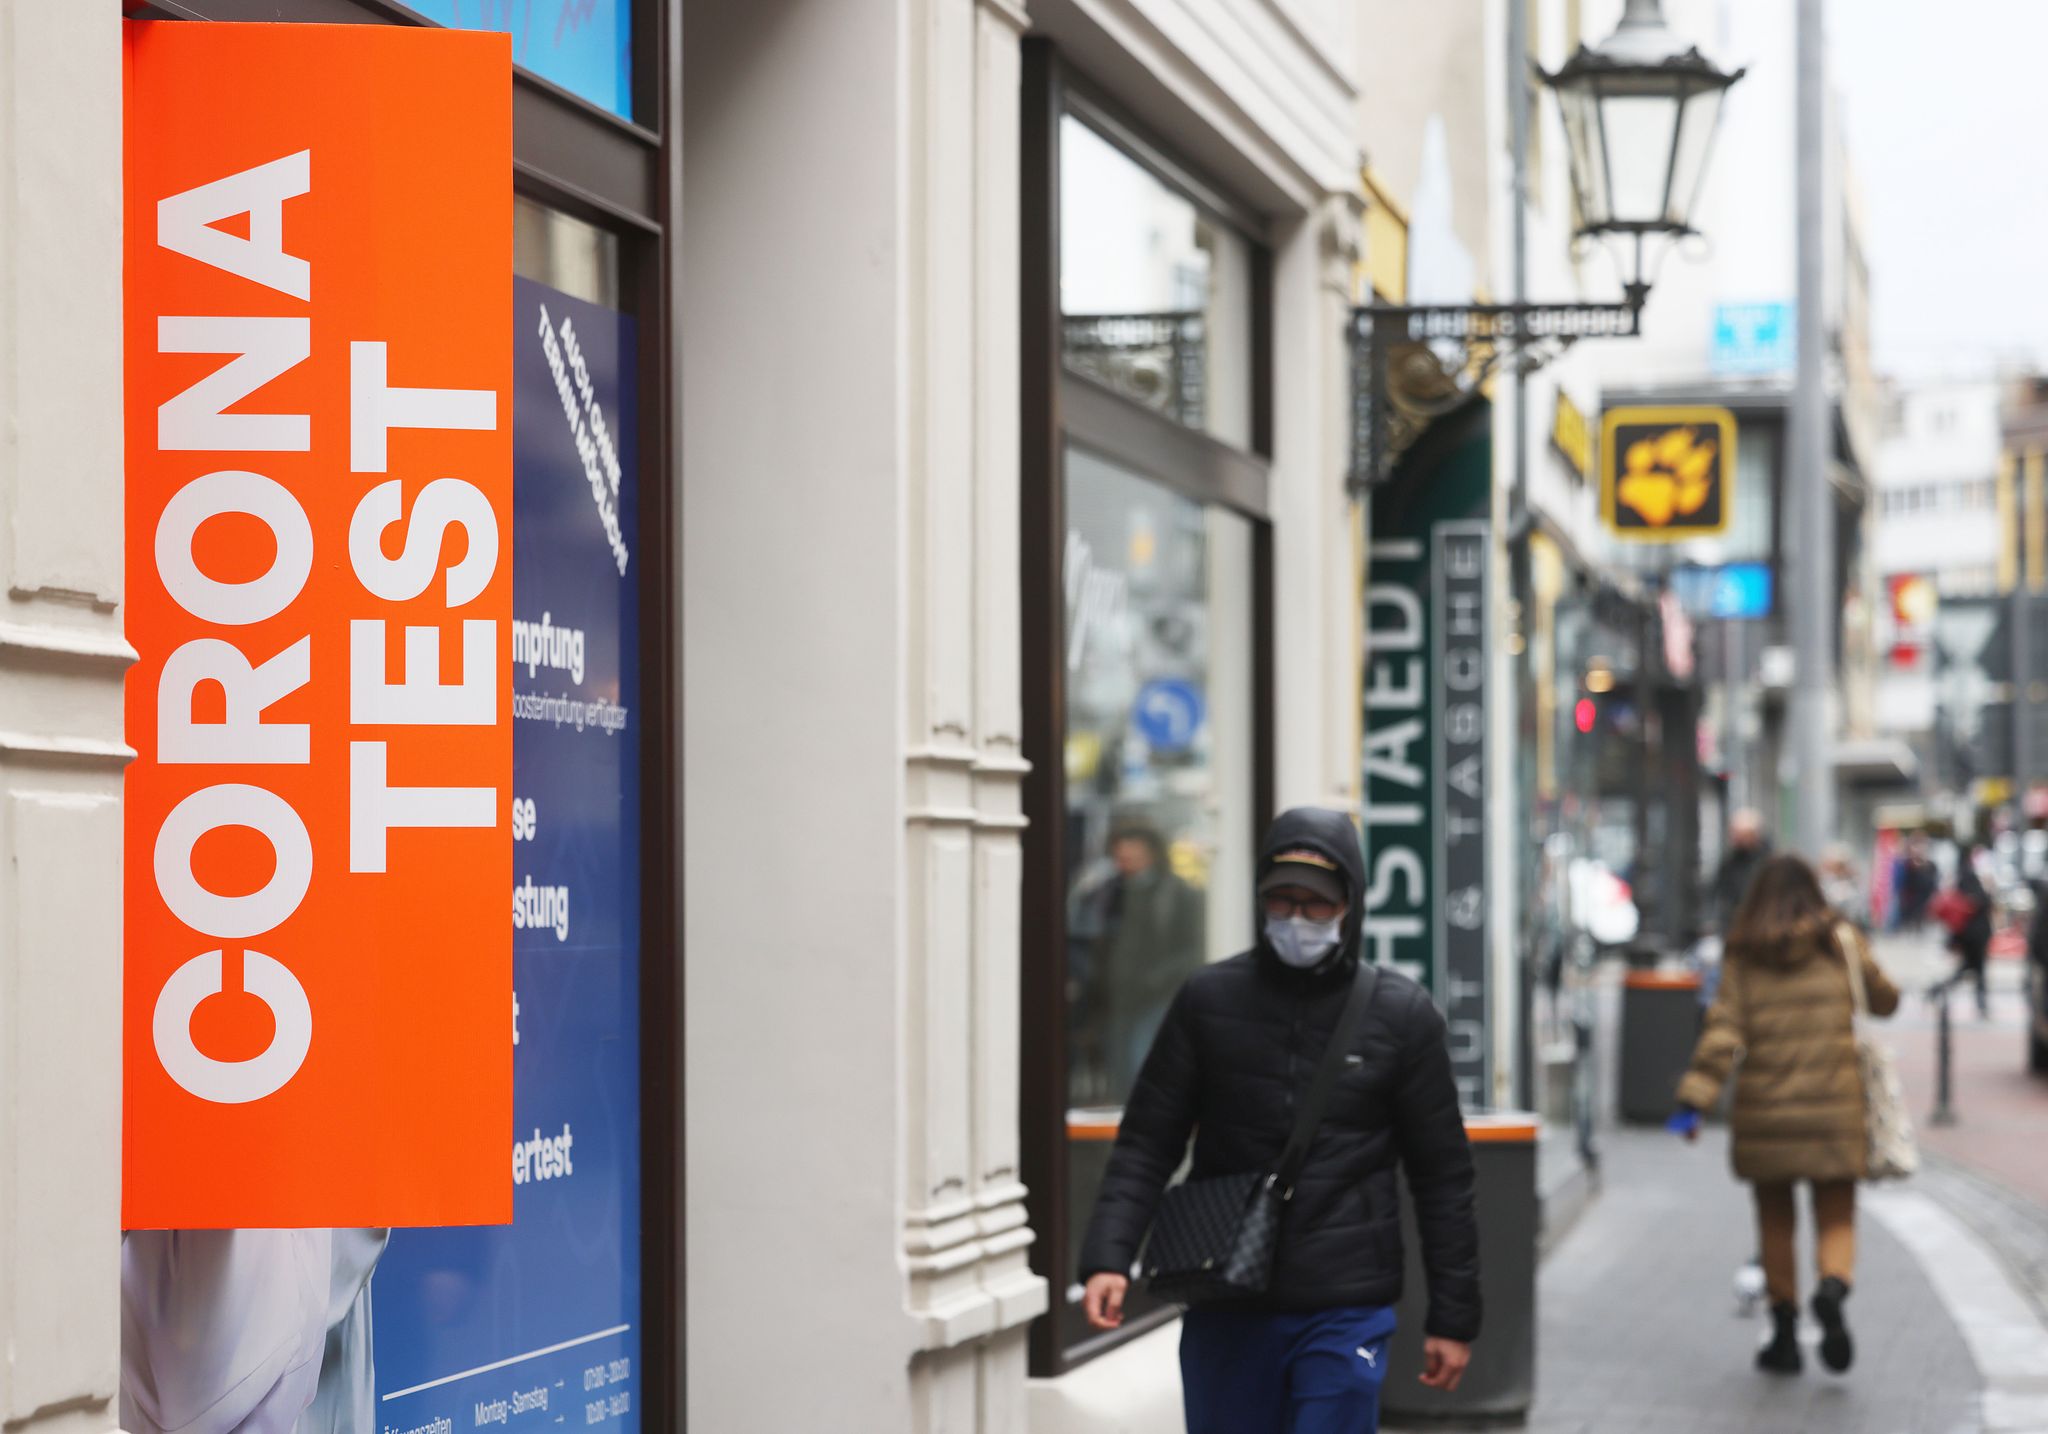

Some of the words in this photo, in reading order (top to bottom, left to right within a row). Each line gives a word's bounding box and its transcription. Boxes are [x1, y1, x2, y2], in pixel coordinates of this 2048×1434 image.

[538, 303, 581, 434] TERMIN
[560, 316, 594, 414] AUCH
[590, 402, 622, 496] OHNE
[153, 148, 314, 1104] CORONA
[349, 341, 499, 872] TEST
[513, 611, 584, 685] mpfung
[513, 688, 584, 732] oosterimpfung
[1445, 542, 1484, 847] TASCHE
[512, 875, 569, 942] stung
[513, 1123, 573, 1184] ertest
[475, 1399, 508, 1427] Montag
[512, 1386, 548, 1415] Samstag
